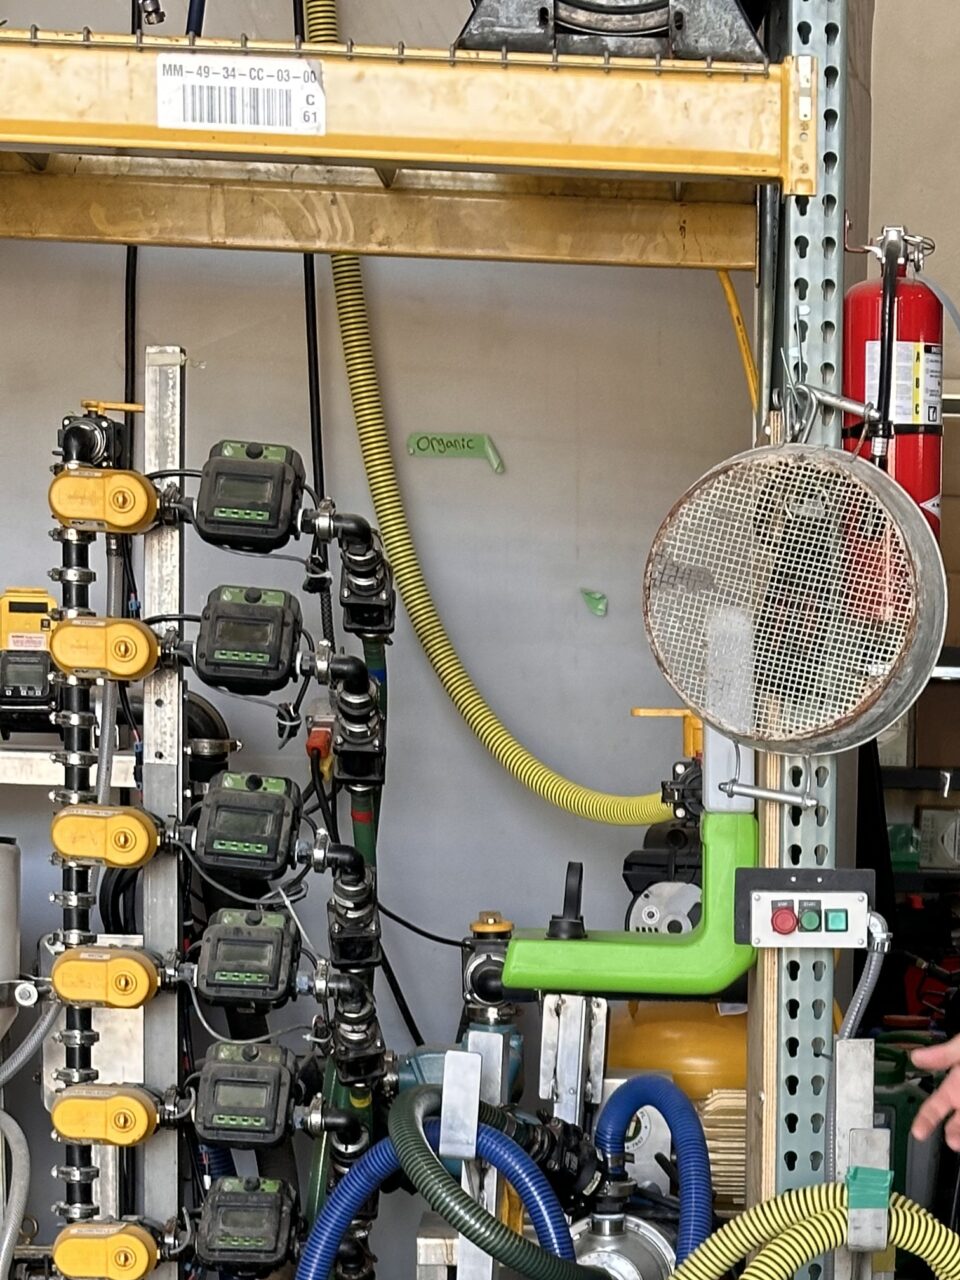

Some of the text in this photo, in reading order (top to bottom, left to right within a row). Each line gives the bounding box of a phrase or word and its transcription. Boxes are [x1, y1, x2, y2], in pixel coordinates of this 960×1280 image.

[305, 94, 315, 106] C
[303, 110, 317, 123] 61
[416, 435, 476, 454] Organic
